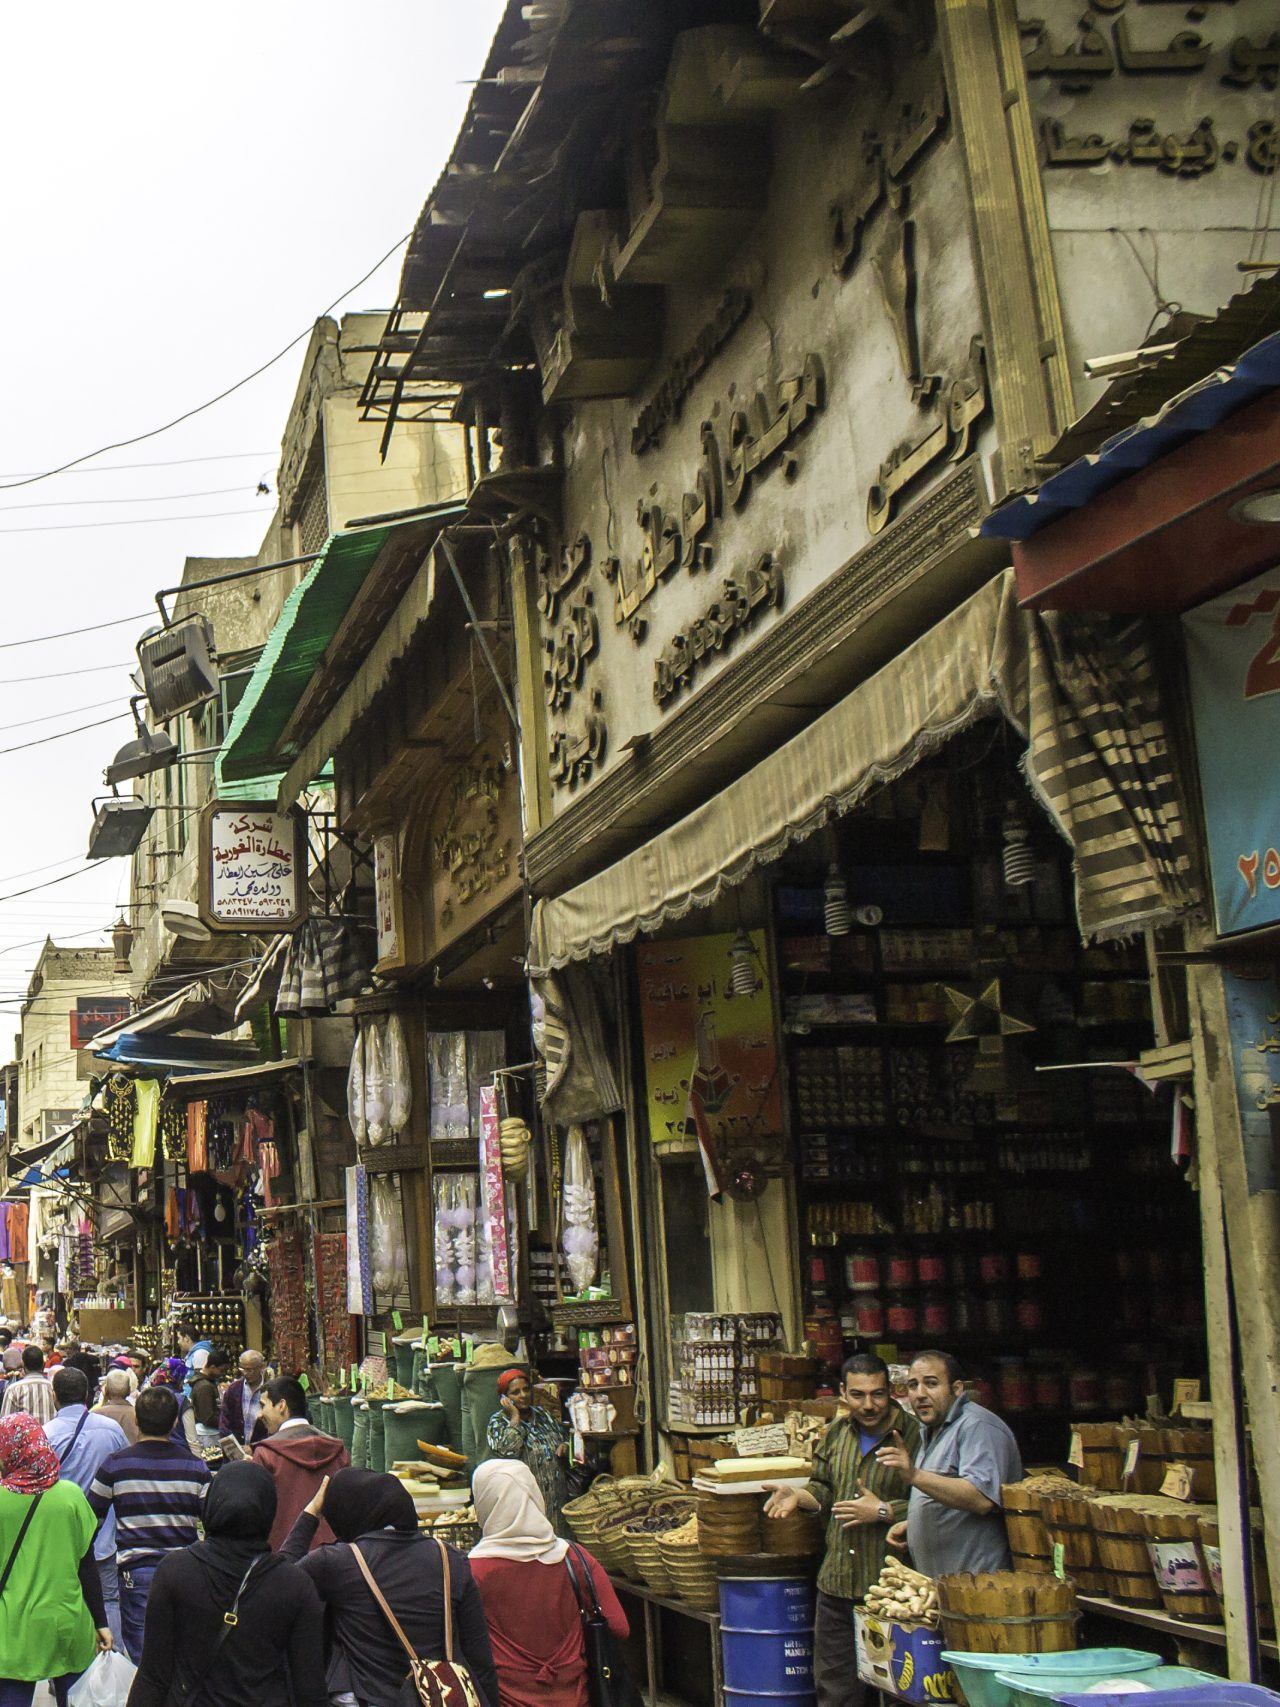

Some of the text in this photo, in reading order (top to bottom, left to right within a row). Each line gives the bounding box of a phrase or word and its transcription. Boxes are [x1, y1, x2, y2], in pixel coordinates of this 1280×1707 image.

[1128, 117, 1218, 178] زيوت
[229, 815, 272, 834] شركة
[213, 836, 292, 864] عطارة الغورية
